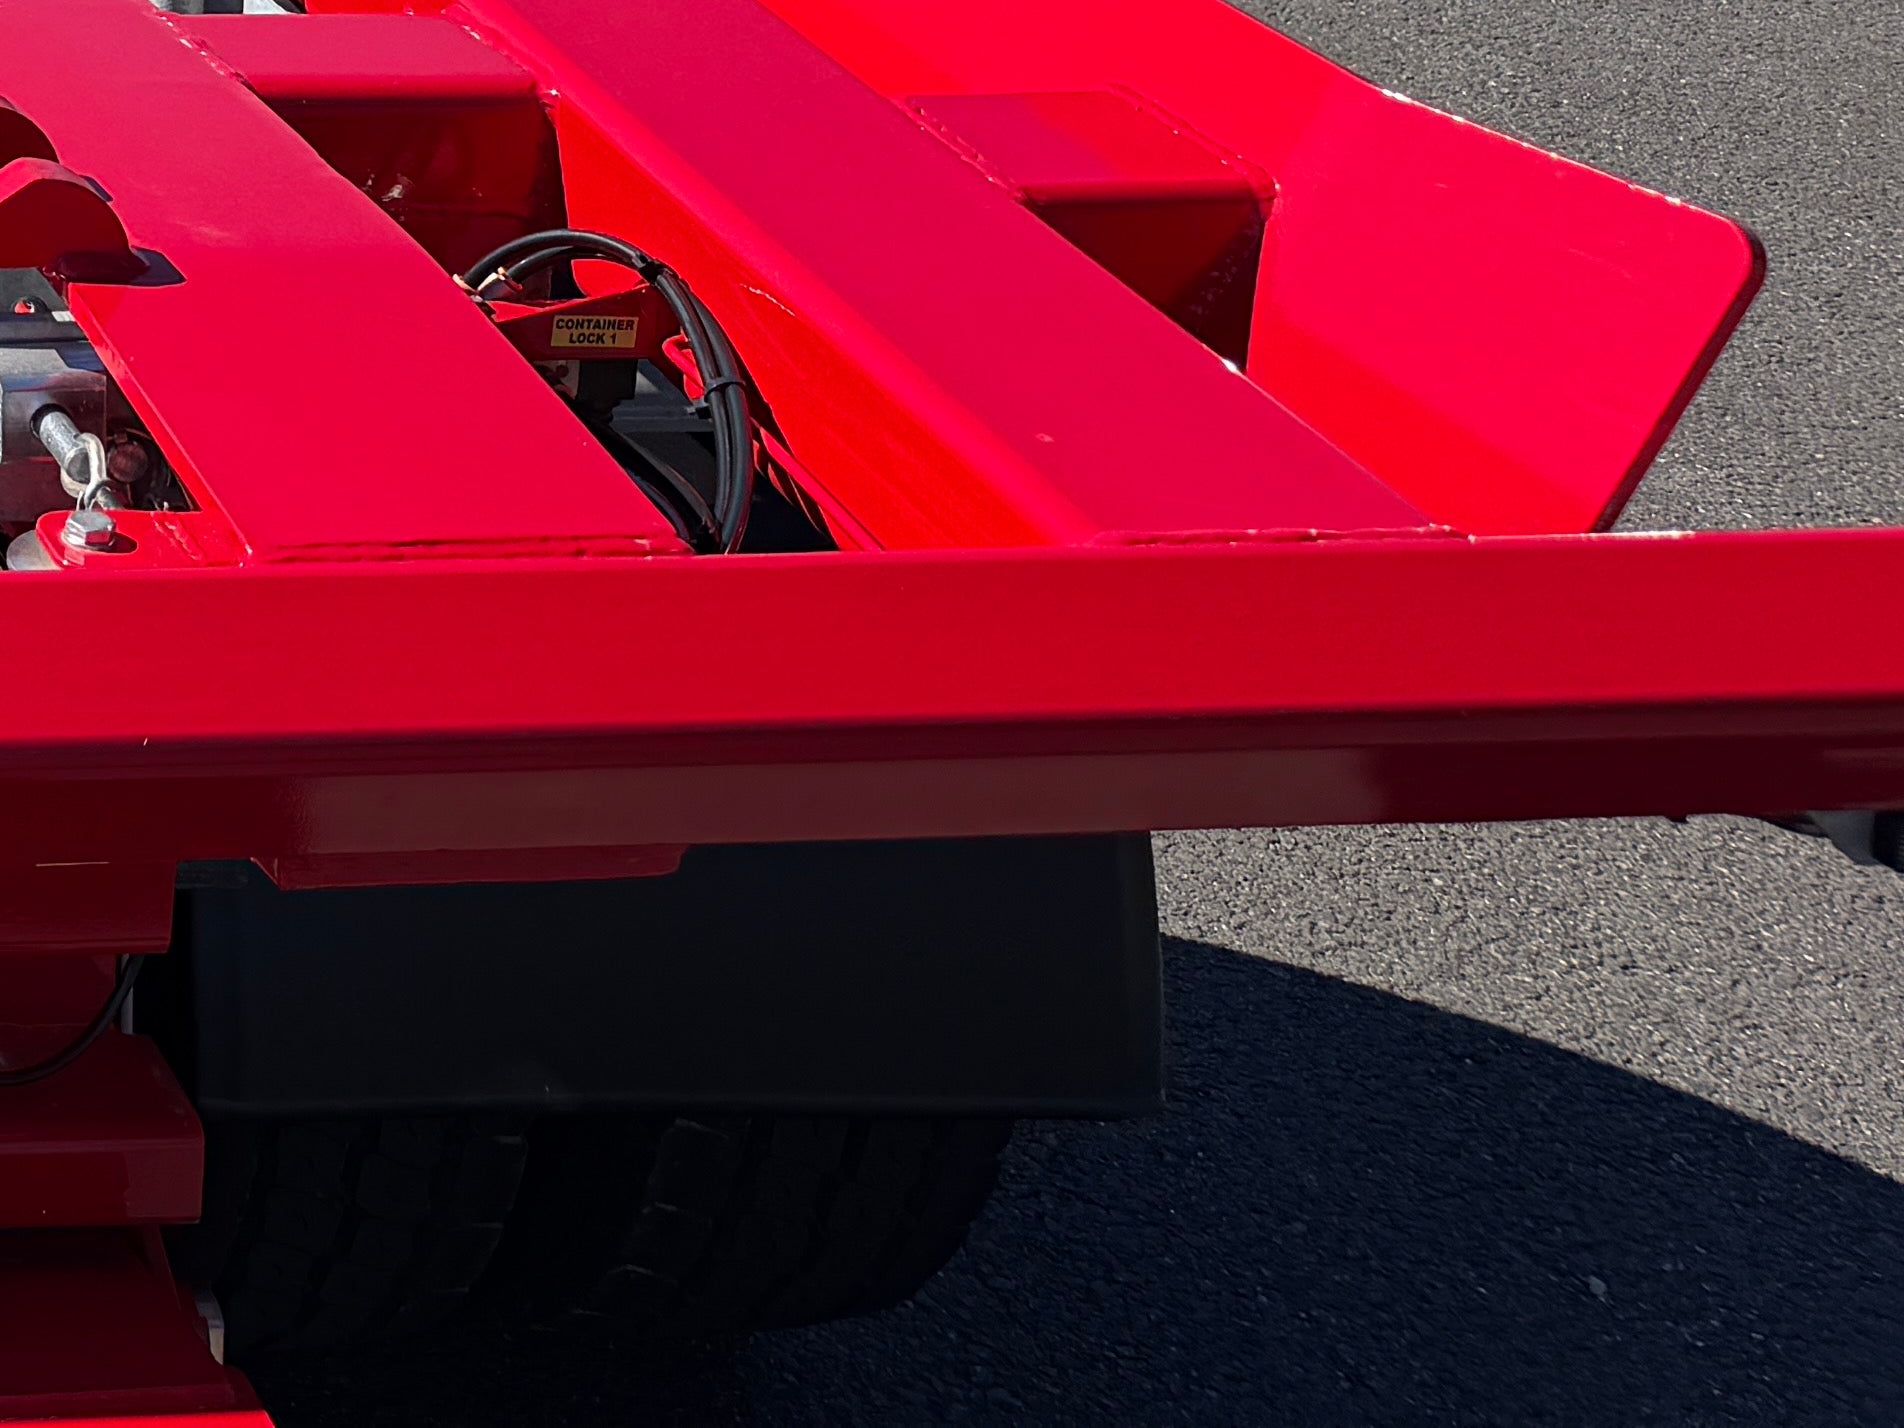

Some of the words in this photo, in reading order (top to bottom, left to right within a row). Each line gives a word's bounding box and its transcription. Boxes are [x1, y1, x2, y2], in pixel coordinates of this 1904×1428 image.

[555, 318, 635, 330] CONTAINER
[568, 332, 606, 344] LOCK
[609, 333, 617, 344] 1
